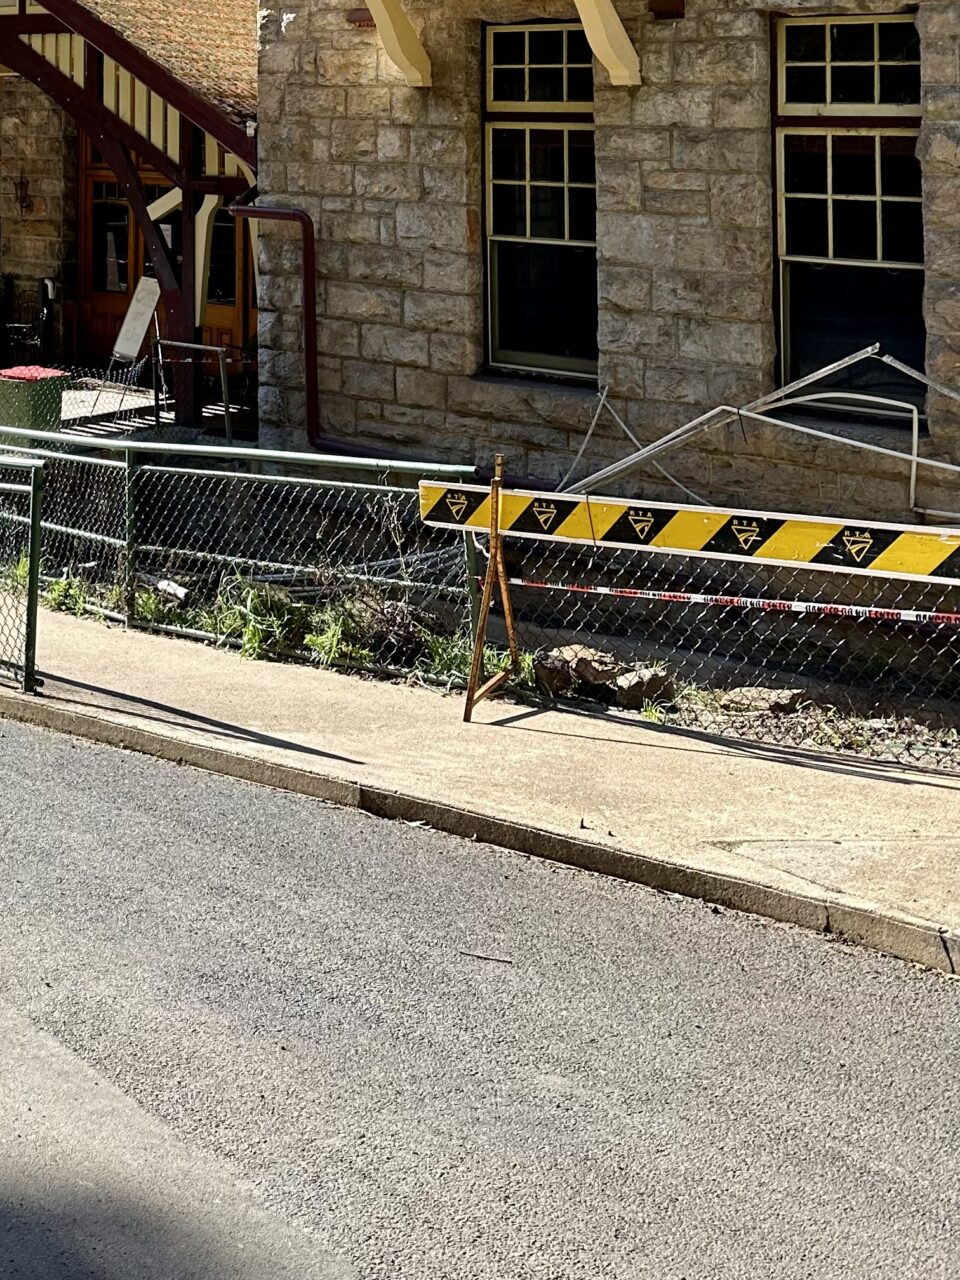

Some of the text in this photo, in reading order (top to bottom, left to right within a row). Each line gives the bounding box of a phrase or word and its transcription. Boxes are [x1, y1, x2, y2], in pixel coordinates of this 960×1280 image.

[629, 510, 652, 518] RTA
[732, 519, 758, 527] RTA
[844, 530, 871, 539] RTA
